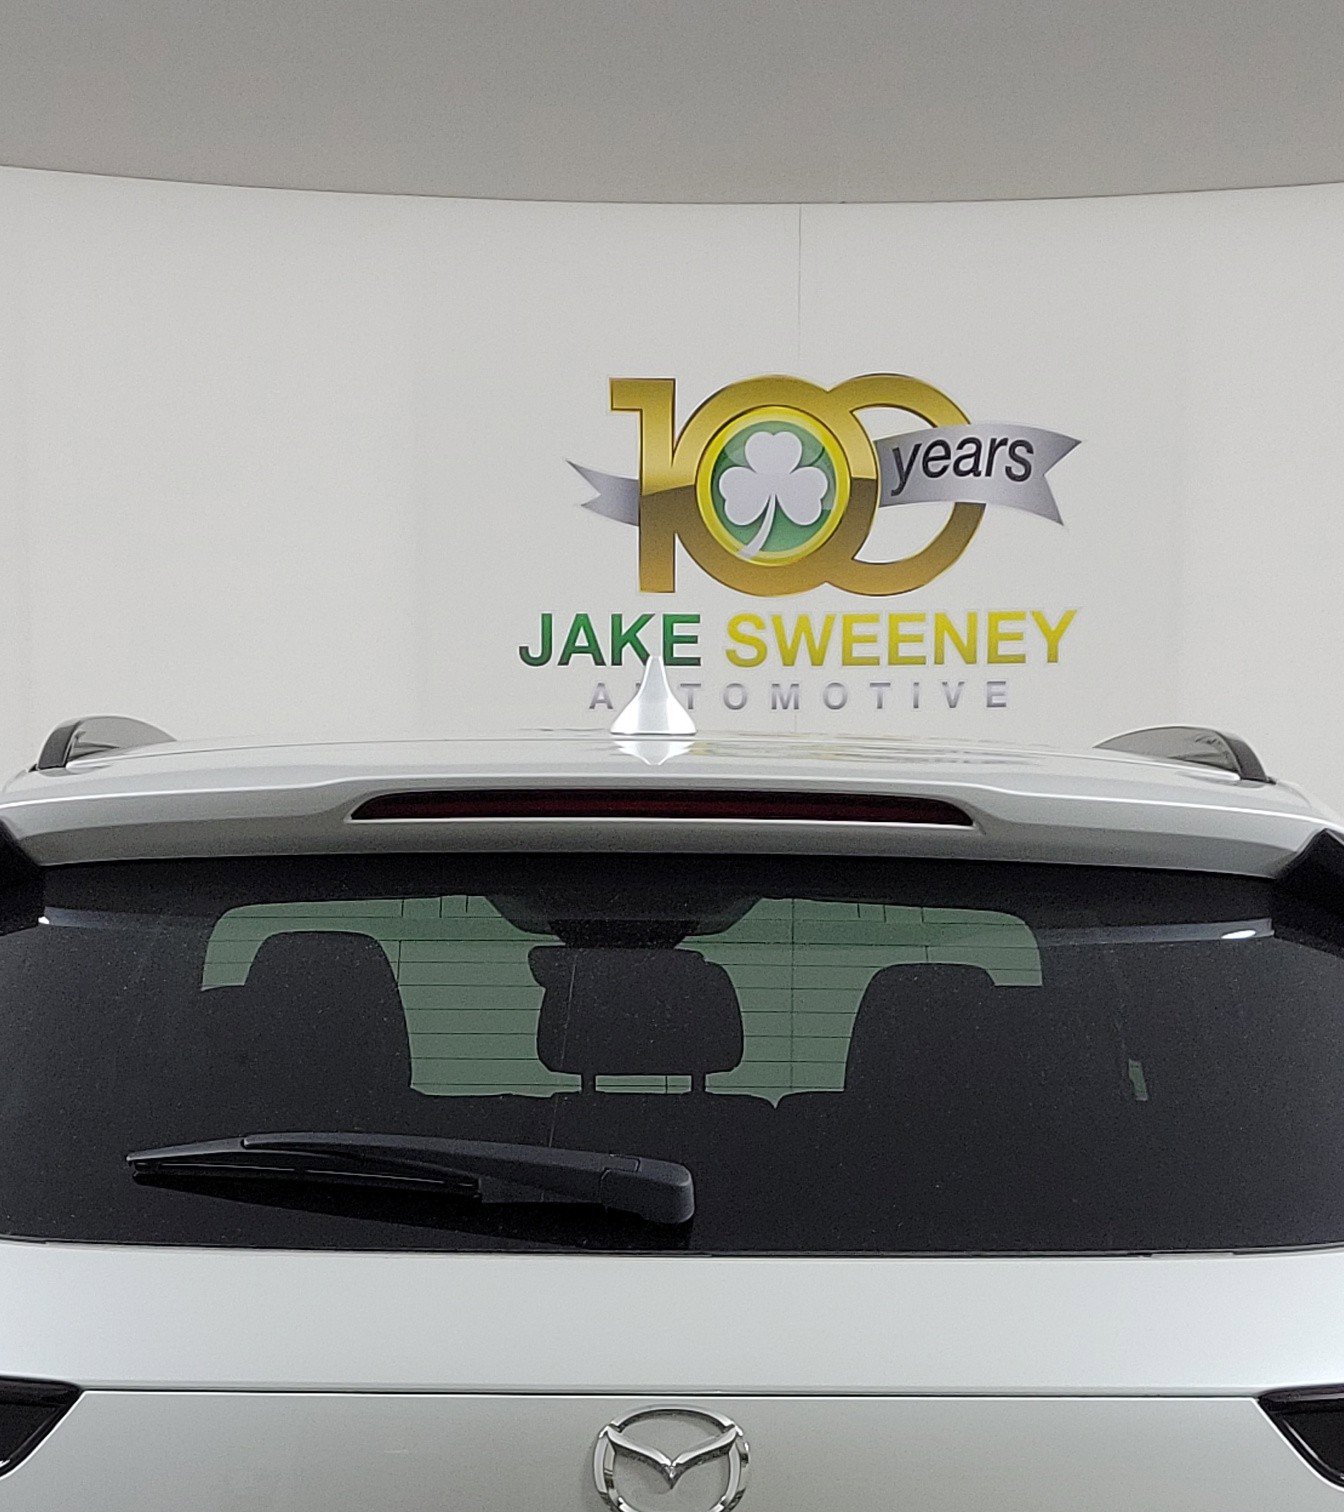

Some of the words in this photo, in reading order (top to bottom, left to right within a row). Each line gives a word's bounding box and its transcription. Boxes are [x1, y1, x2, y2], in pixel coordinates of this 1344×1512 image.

[609, 373, 987, 598] 100
[890, 432, 1035, 499] years
[518, 612, 701, 668] JAKE
[724, 608, 1078, 668] SWEENEY
[588, 680, 1008, 711] ATOMOTIVE
